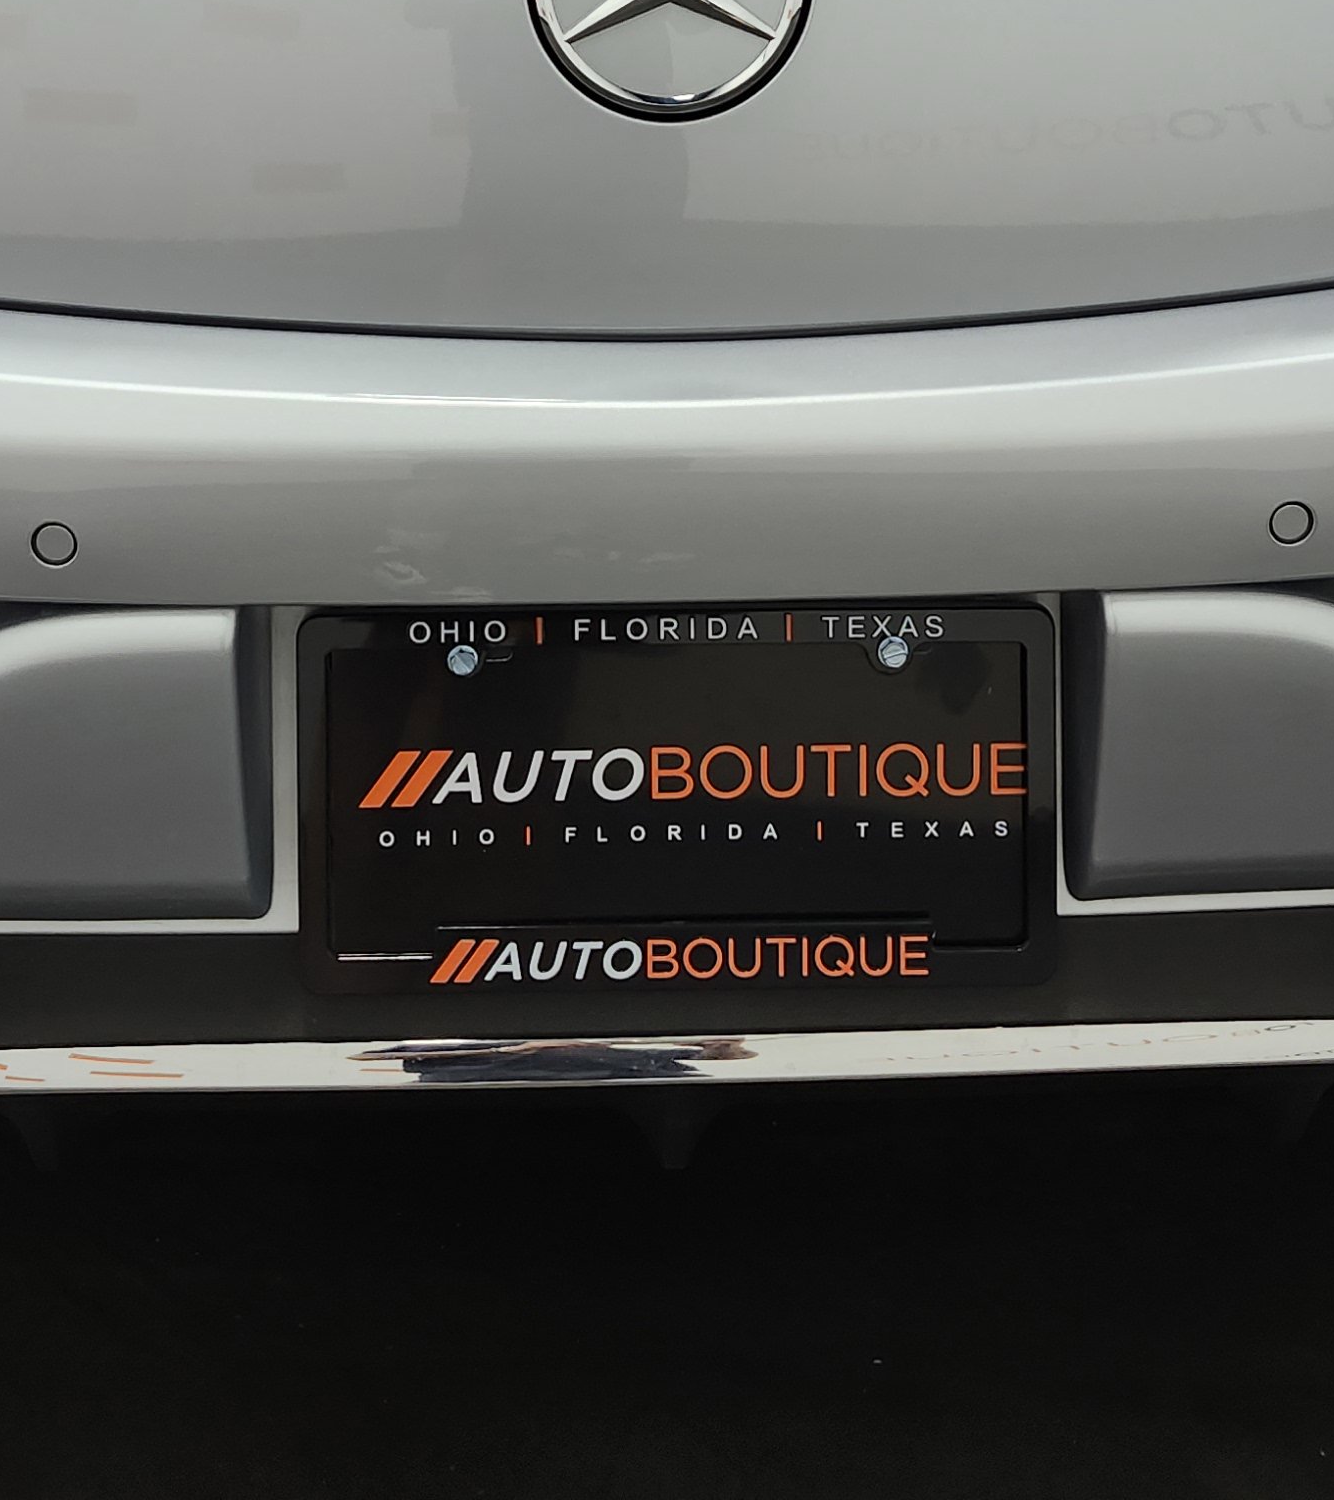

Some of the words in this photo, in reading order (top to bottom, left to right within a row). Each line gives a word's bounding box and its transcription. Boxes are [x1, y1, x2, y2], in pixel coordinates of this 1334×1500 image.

[408, 619, 508, 644] OHIO
[573, 615, 760, 642] FLORIDA
[821, 614, 946, 639] TEXAS
[378, 826, 496, 848] OHIO
[564, 822, 779, 843] FLORIDA
[856, 819, 1010, 839] TEXAS
